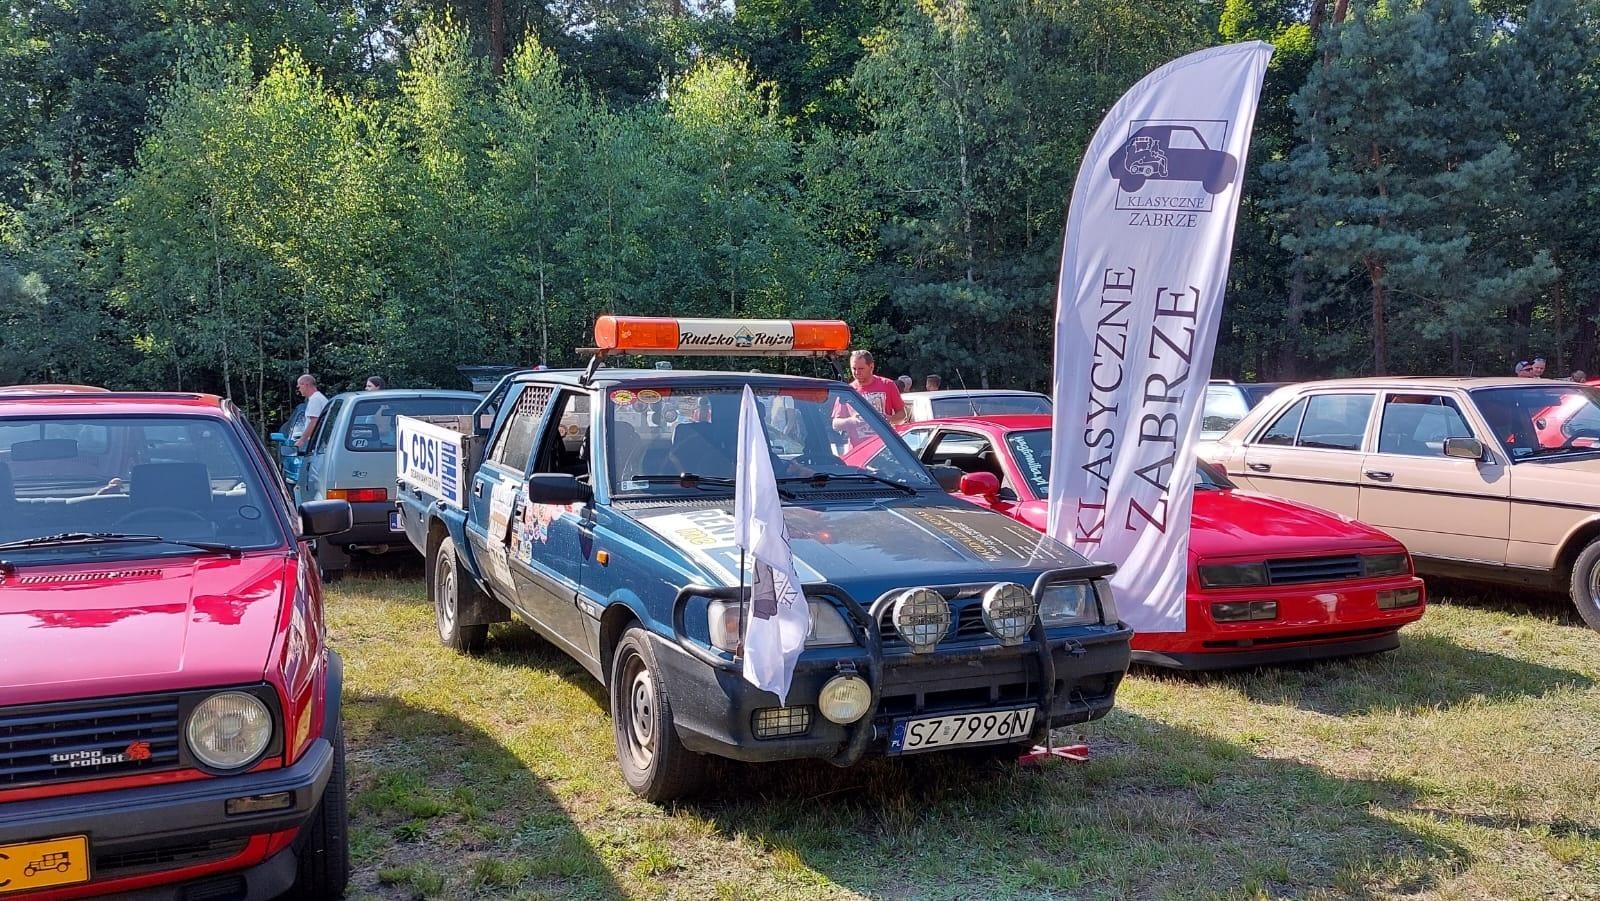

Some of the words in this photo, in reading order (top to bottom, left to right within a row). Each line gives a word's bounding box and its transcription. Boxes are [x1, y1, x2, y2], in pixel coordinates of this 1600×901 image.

[1127, 196, 1205, 209] KLASYCZNE
[1128, 212, 1198, 228] ZABRZE
[680, 331, 735, 346] Rudzko
[1075, 266, 1136, 546] KLASYCZNE
[1125, 285, 1201, 535] ZABRZE
[411, 433, 439, 477] CDSI
[908, 719, 943, 747] SZ
[949, 711, 1030, 742] 7996N
[890, 740, 901, 748] PL
[50, 750, 102, 762] turbo
[70, 753, 125, 768] rabbit
